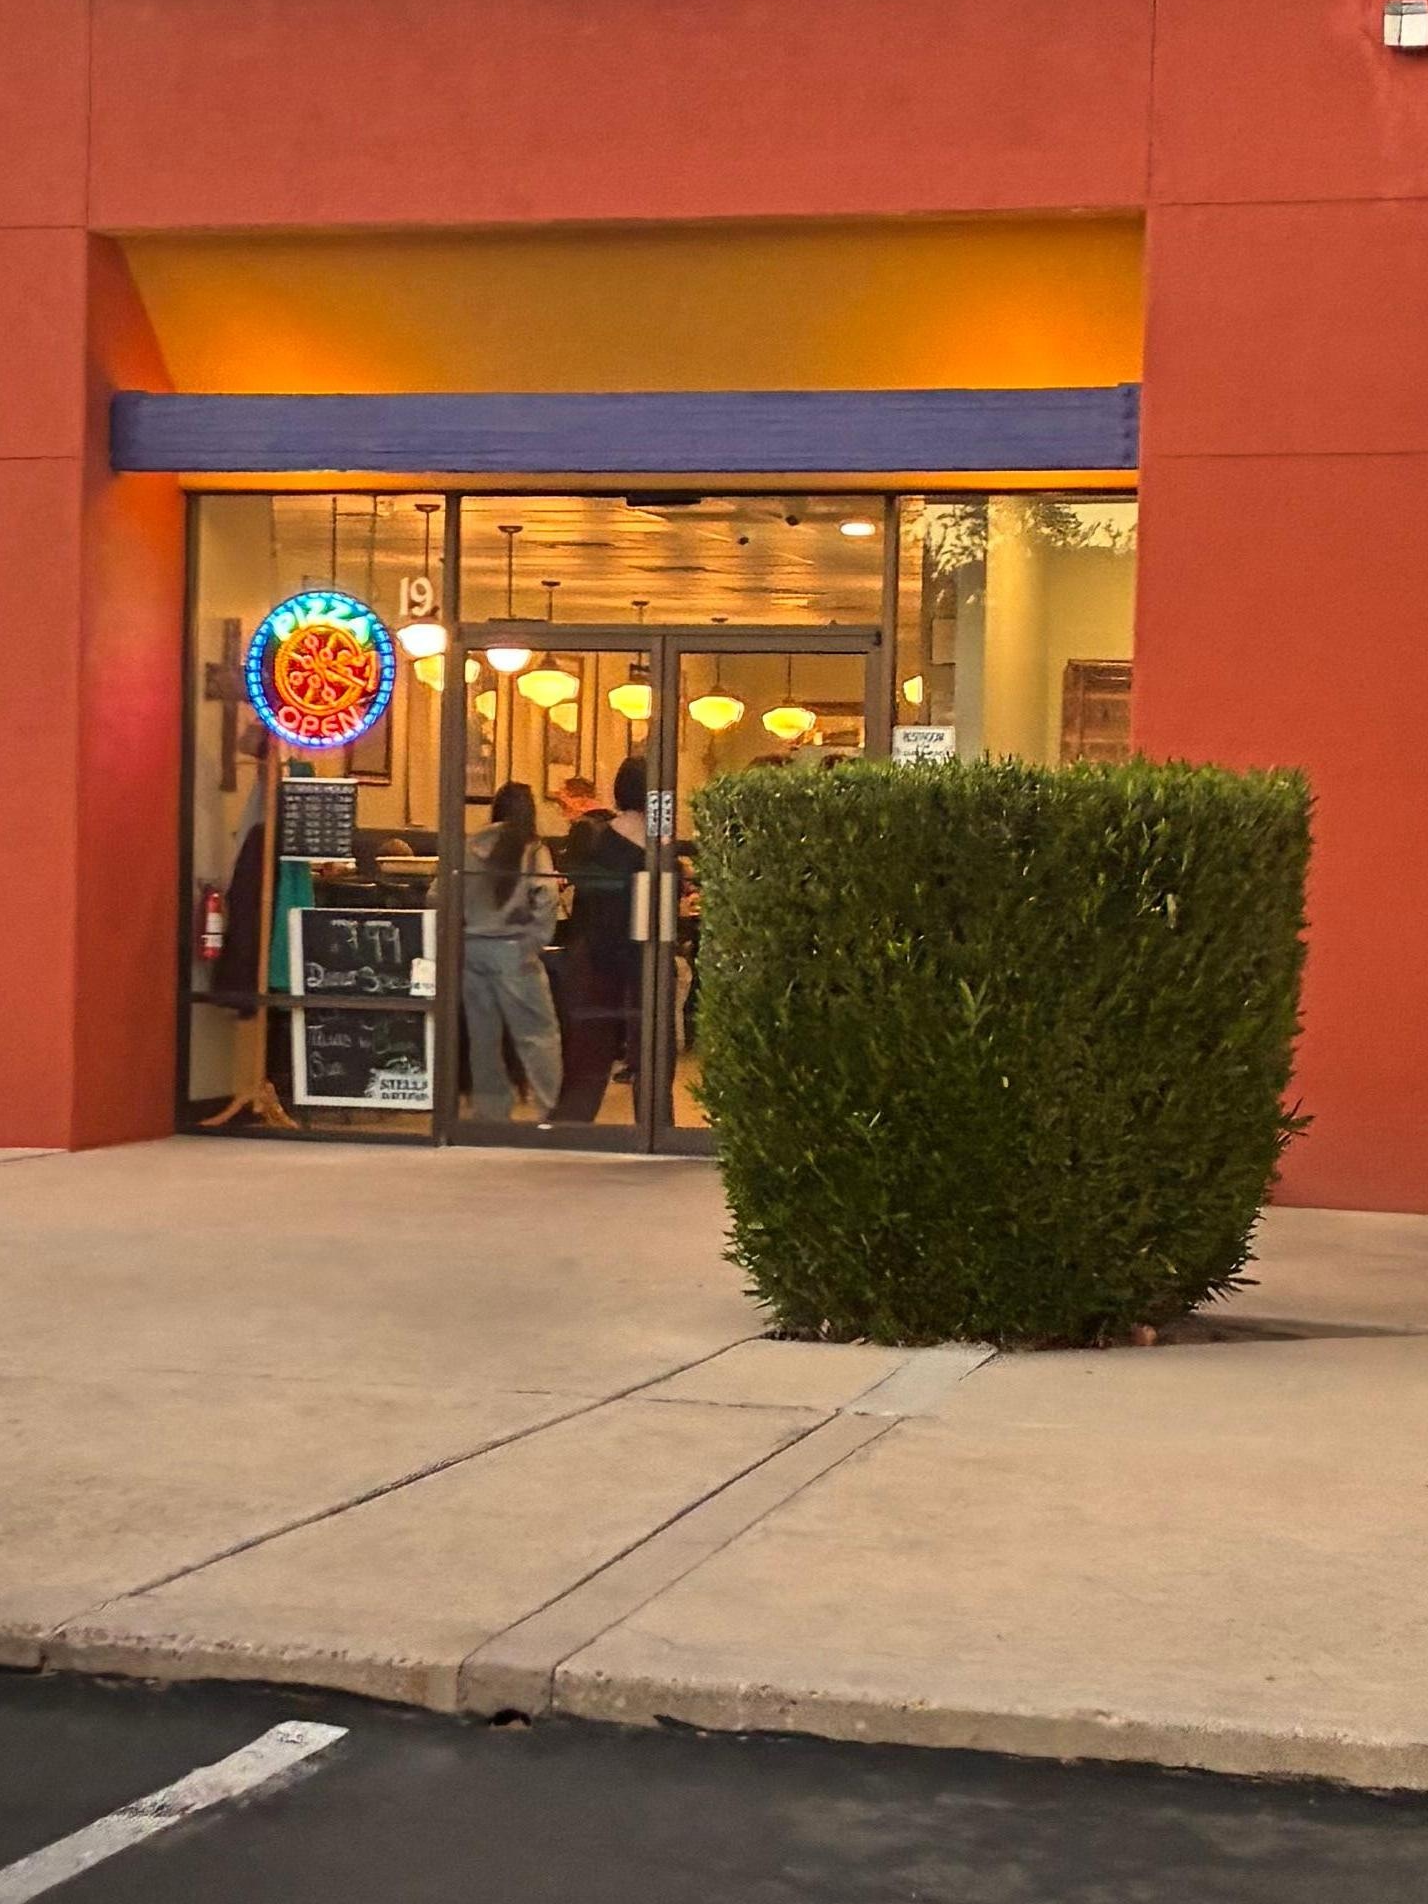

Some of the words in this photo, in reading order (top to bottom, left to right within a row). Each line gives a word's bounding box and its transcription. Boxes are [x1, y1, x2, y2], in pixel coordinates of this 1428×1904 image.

[399, 576, 434, 616] 19
[271, 597, 373, 645] PIZZA
[277, 704, 362, 737] OPEN
